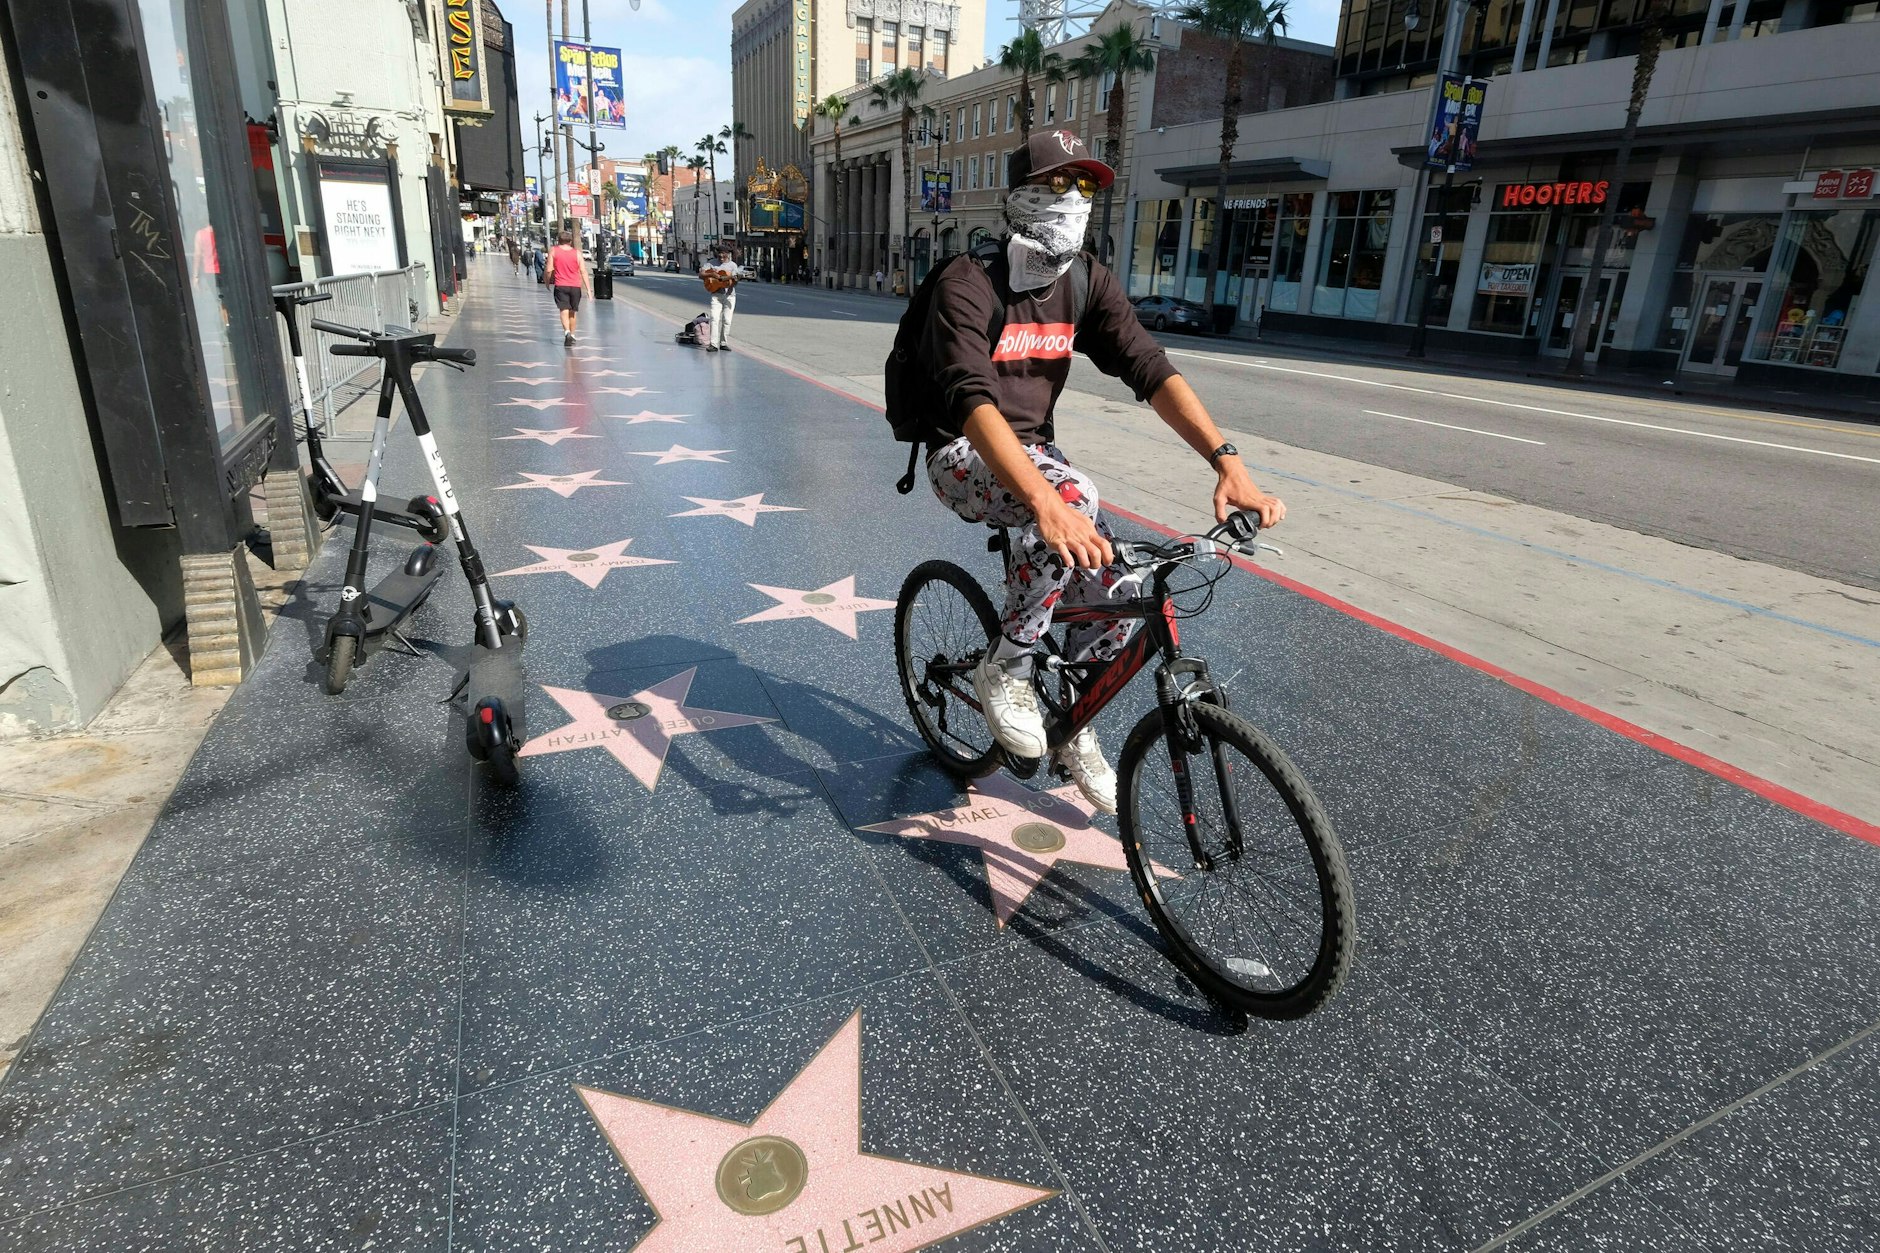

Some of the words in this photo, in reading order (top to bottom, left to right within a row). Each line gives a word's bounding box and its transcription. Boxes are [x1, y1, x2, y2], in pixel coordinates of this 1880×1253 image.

[447, 0, 475, 79] SE
[796, 10, 808, 119] CAPITAN
[1818, 178, 1840, 186] MINI
[1503, 180, 1609, 207] HOOTERS
[346, 199, 367, 212] HE'S
[1223, 200, 1233, 210] NE
[1233, 199, 1268, 209] FRIENDS
[336, 212, 381, 226] STANDING
[334, 225, 360, 238] RIGHT
[363, 226, 386, 238] NEXT
[1502, 267, 1532, 280] OPEN
[523, 564, 565, 572] JONES
[570, 561, 594, 569] LEE
[600, 559, 646, 567] TOMMY
[787, 606, 833, 616] VELEZ
[838, 602, 870, 612] LUPE
[653, 715, 716, 732] QUEEN
[547, 724, 638, 748] LATIFAH
[913, 806, 1009, 833] MICHAEL
[1018, 789, 1086, 814] JACKSO
